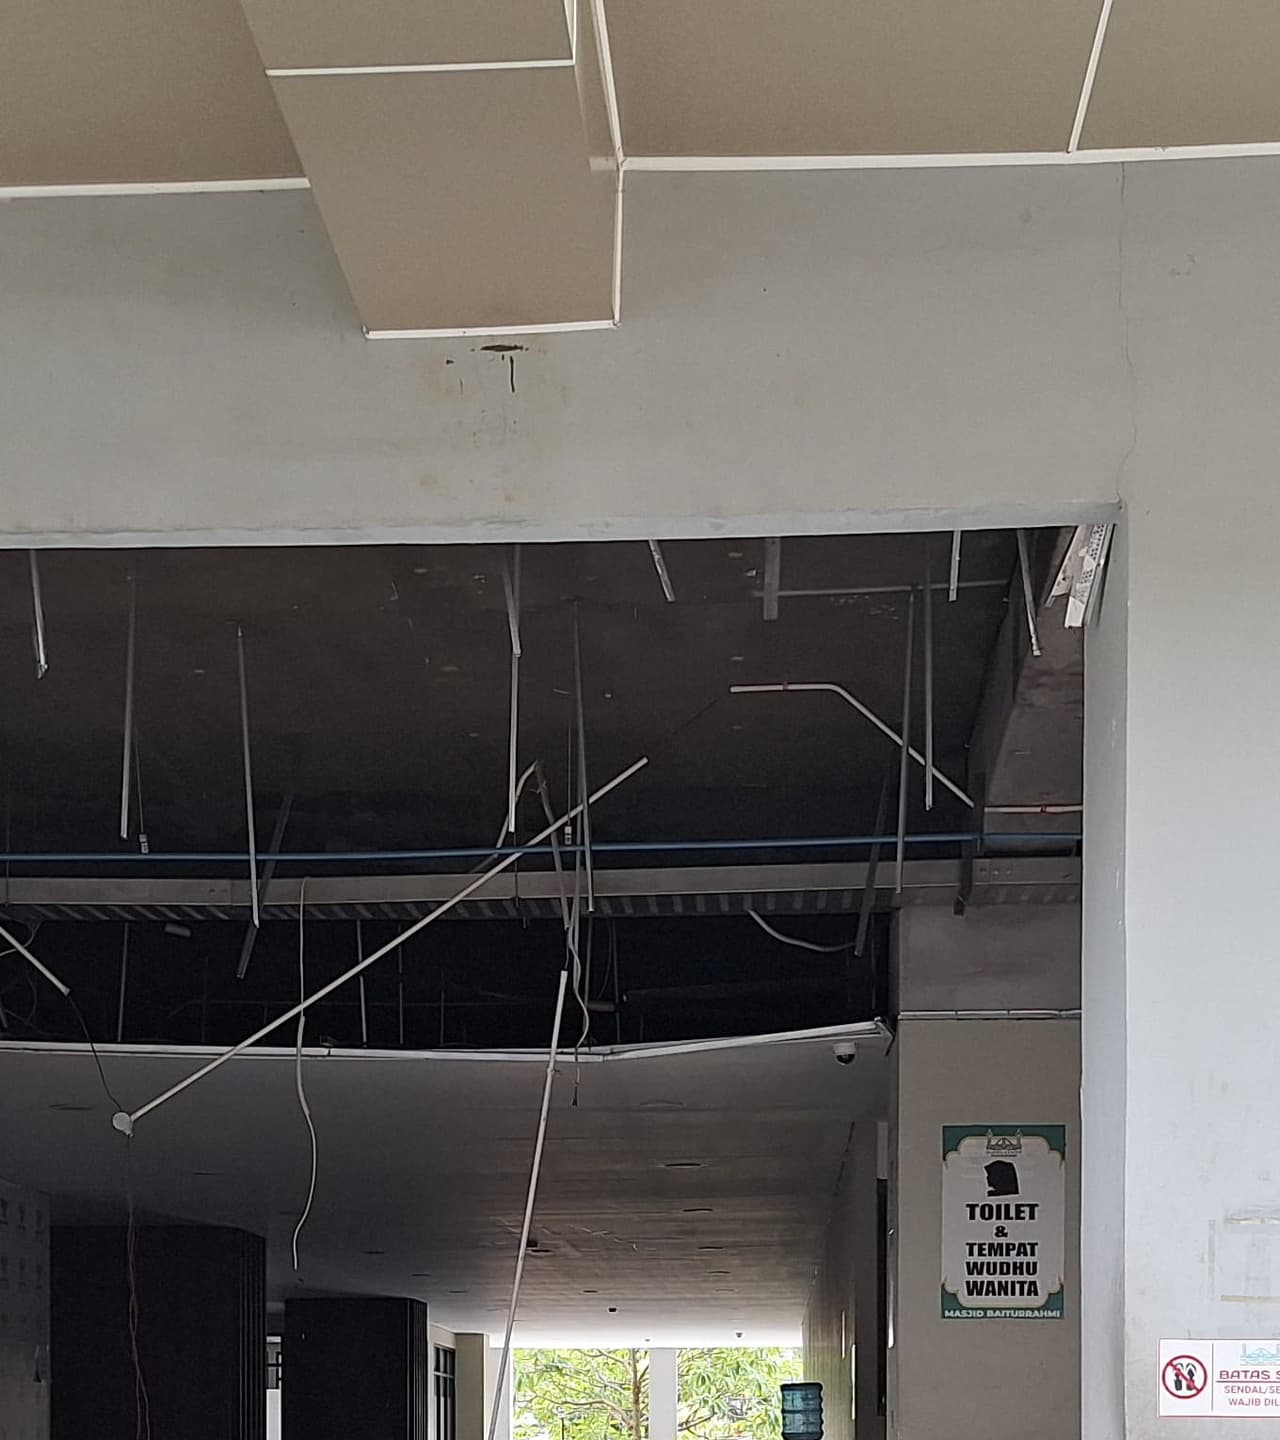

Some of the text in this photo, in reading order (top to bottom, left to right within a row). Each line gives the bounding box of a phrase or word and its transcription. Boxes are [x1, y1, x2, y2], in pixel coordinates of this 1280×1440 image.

[966, 1203, 1039, 1220] TOILET
[994, 1225, 1008, 1238] &
[966, 1242, 1038, 1257] TEMPAT
[965, 1261, 1038, 1276] WUDHU
[965, 1280, 1039, 1297] WANITA
[944, 1309, 984, 1318] MASJID
[1219, 1369, 1270, 1380] BATAS
[1228, 1397, 1261, 1406] WAJIB
